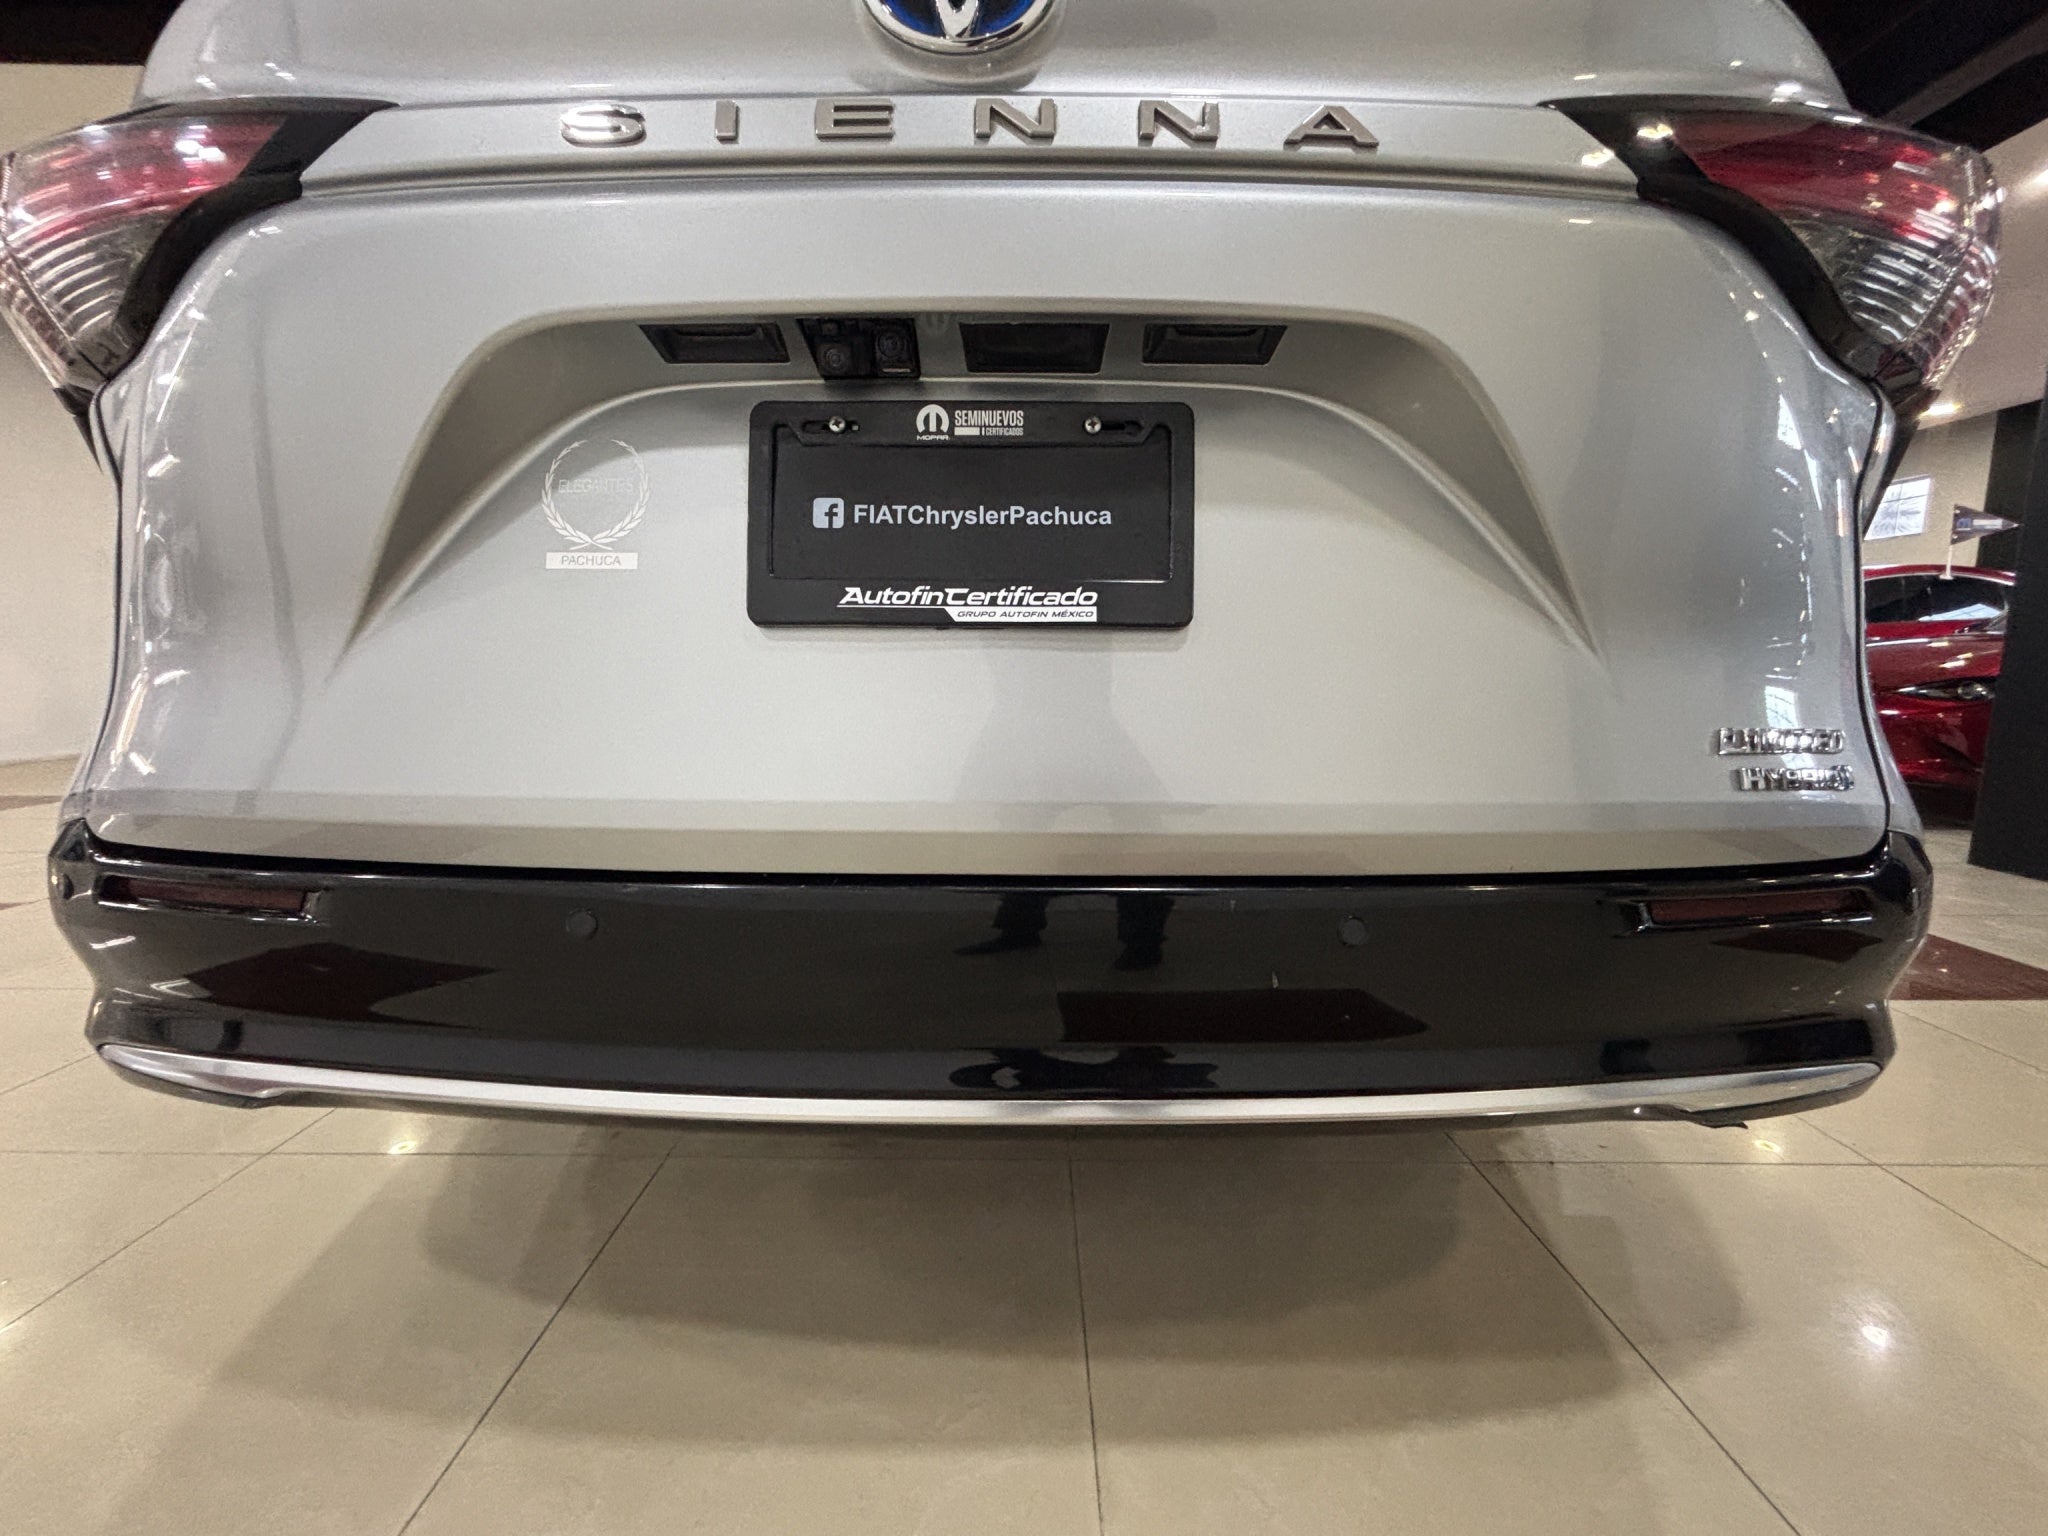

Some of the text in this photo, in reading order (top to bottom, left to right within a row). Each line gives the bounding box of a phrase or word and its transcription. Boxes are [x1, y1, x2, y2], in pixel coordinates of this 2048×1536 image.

[560, 98, 1379, 147] SIENNA
[954, 410, 1025, 426] SEMINUEVOS
[985, 427, 1025, 437] CERTIFICADOS
[853, 503, 1113, 530] FIATChryslerPachuca
[561, 555, 622, 566] PACHUCA
[957, 608, 1094, 618] GRUPO AUTOFIN MÉXICO
